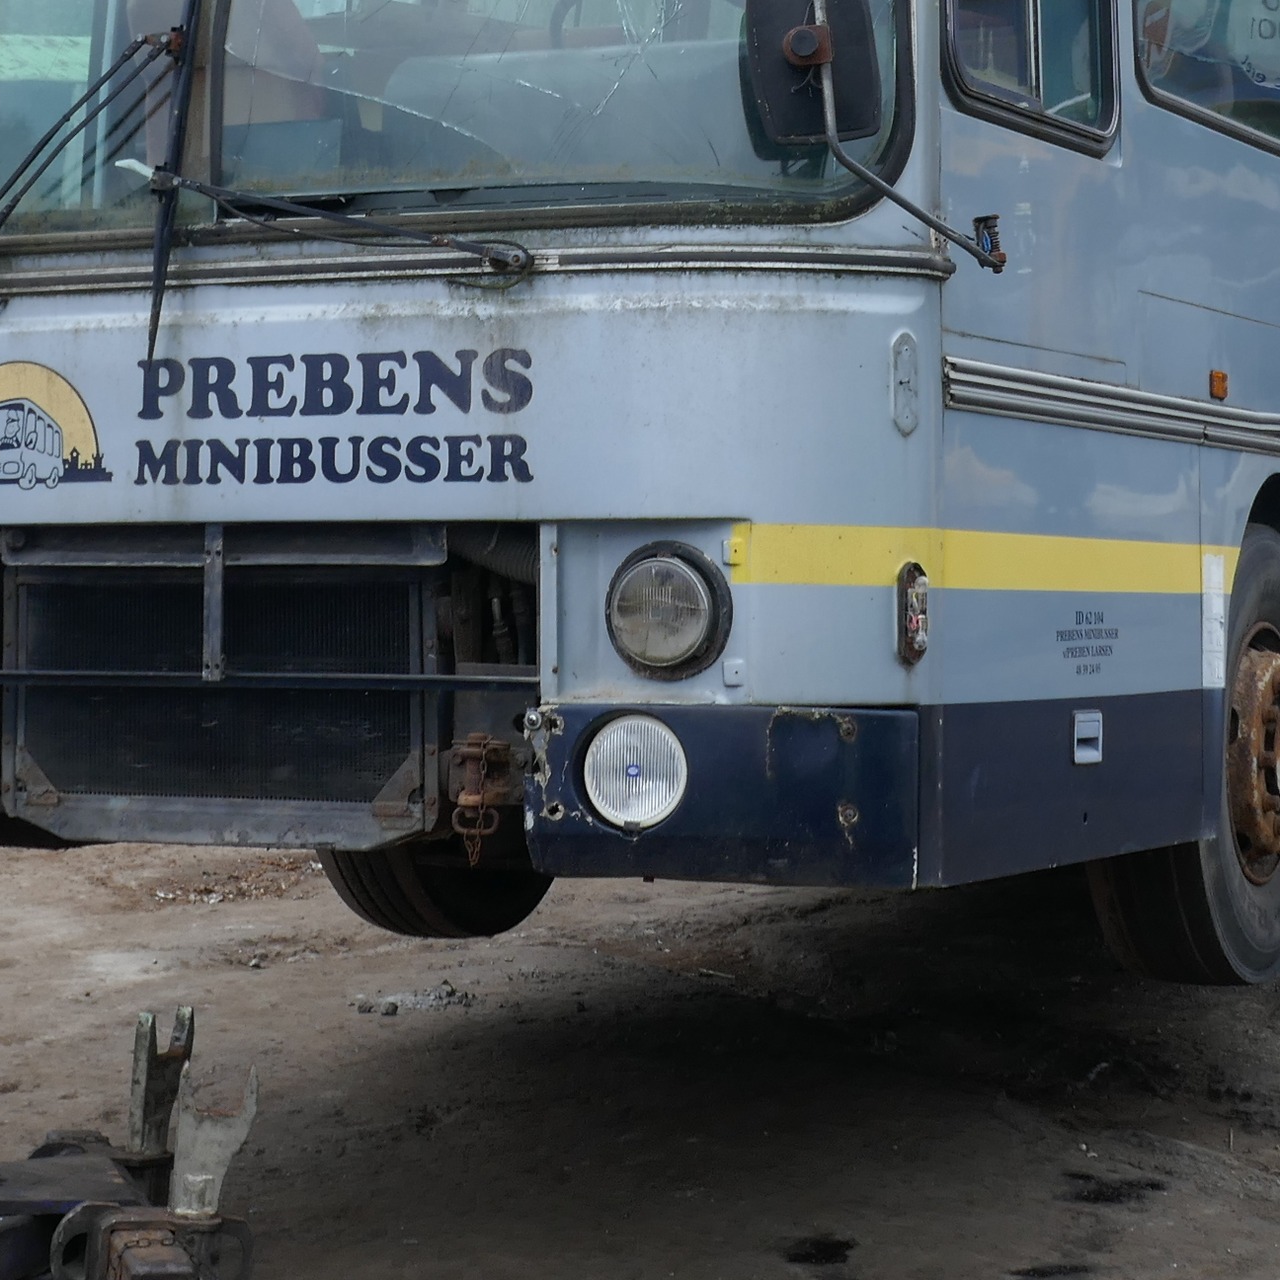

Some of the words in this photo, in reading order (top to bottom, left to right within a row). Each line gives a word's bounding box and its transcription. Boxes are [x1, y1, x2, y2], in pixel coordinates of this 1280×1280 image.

[137, 348, 534, 421] PREBENS
[133, 434, 535, 487] MINIBUSSER
[1056, 629, 1083, 642] PREBENS
